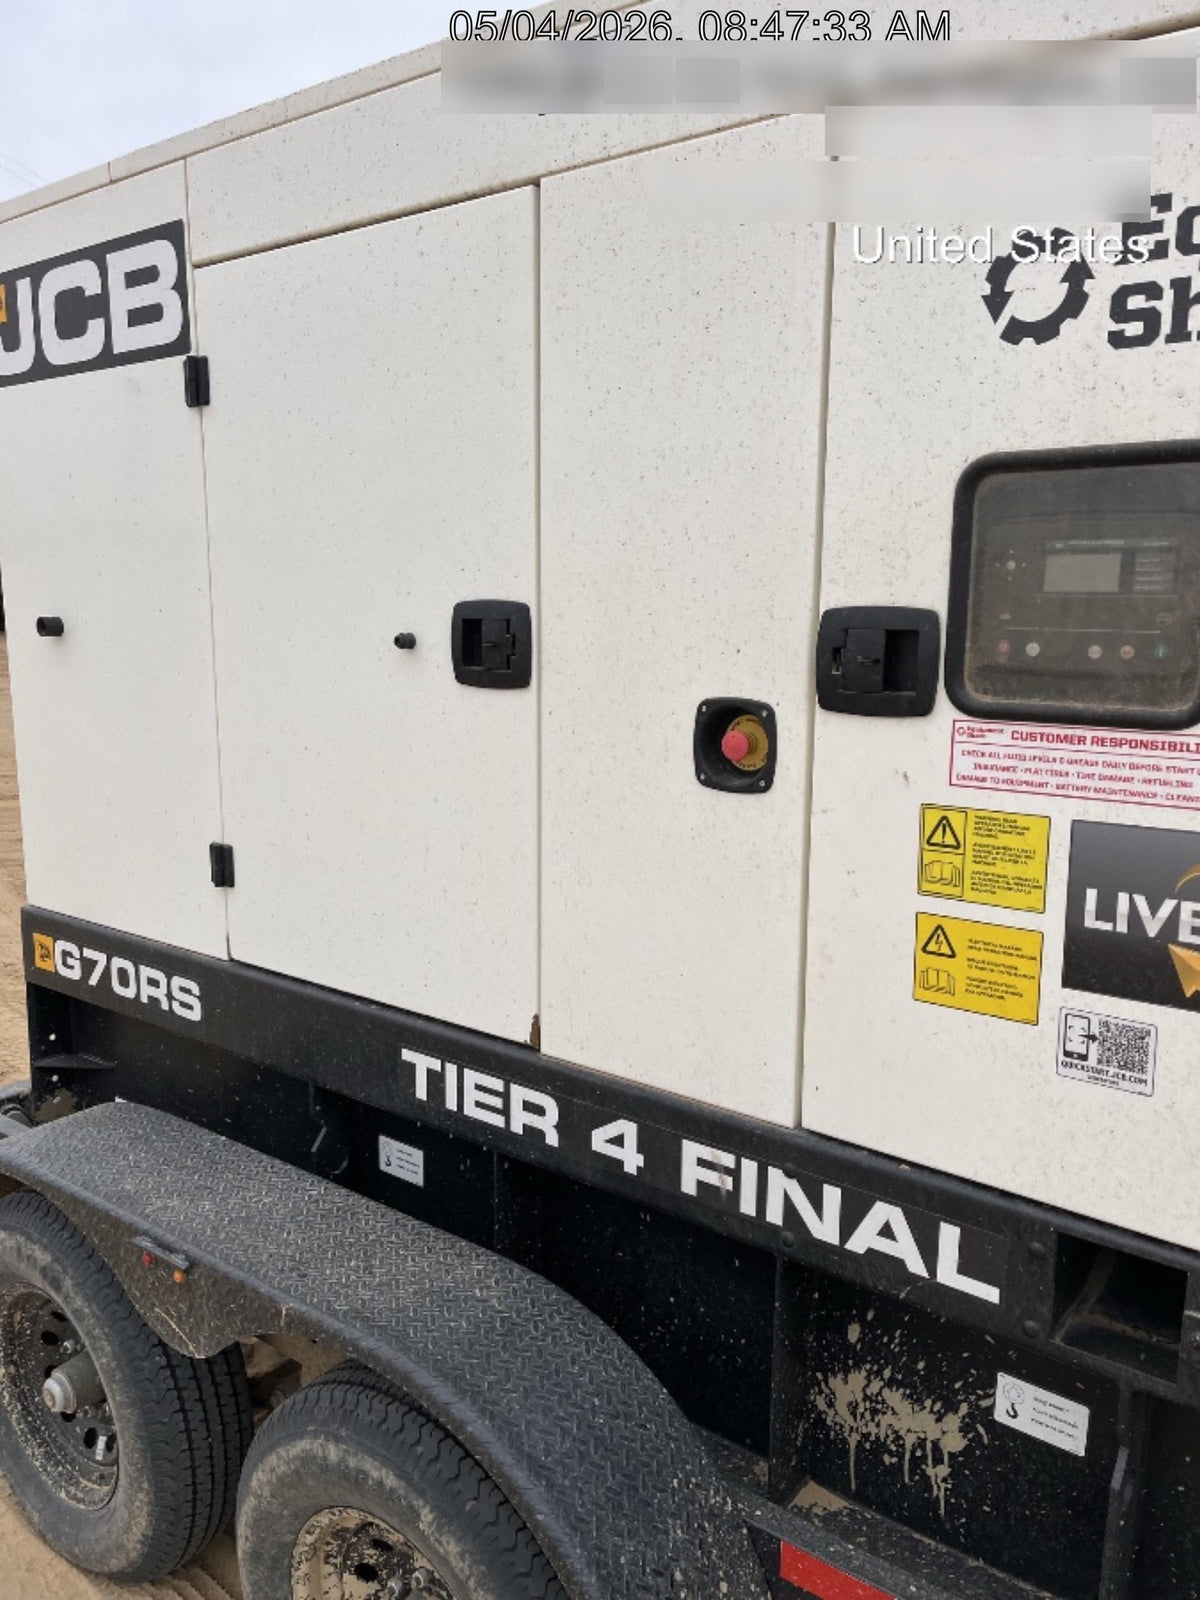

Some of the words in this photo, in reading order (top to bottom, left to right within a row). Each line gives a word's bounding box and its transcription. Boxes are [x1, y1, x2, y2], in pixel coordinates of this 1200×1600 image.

[0, 239, 183, 377] JCB
[1011, 730, 1087, 747] CUSTOMER
[1084, 887, 1200, 945] LIVE
[54, 939, 202, 1022] G70RS
[401, 1048, 560, 1148] TIER
[591, 1118, 645, 1176] 4
[681, 1139, 1001, 1305] FINAL
